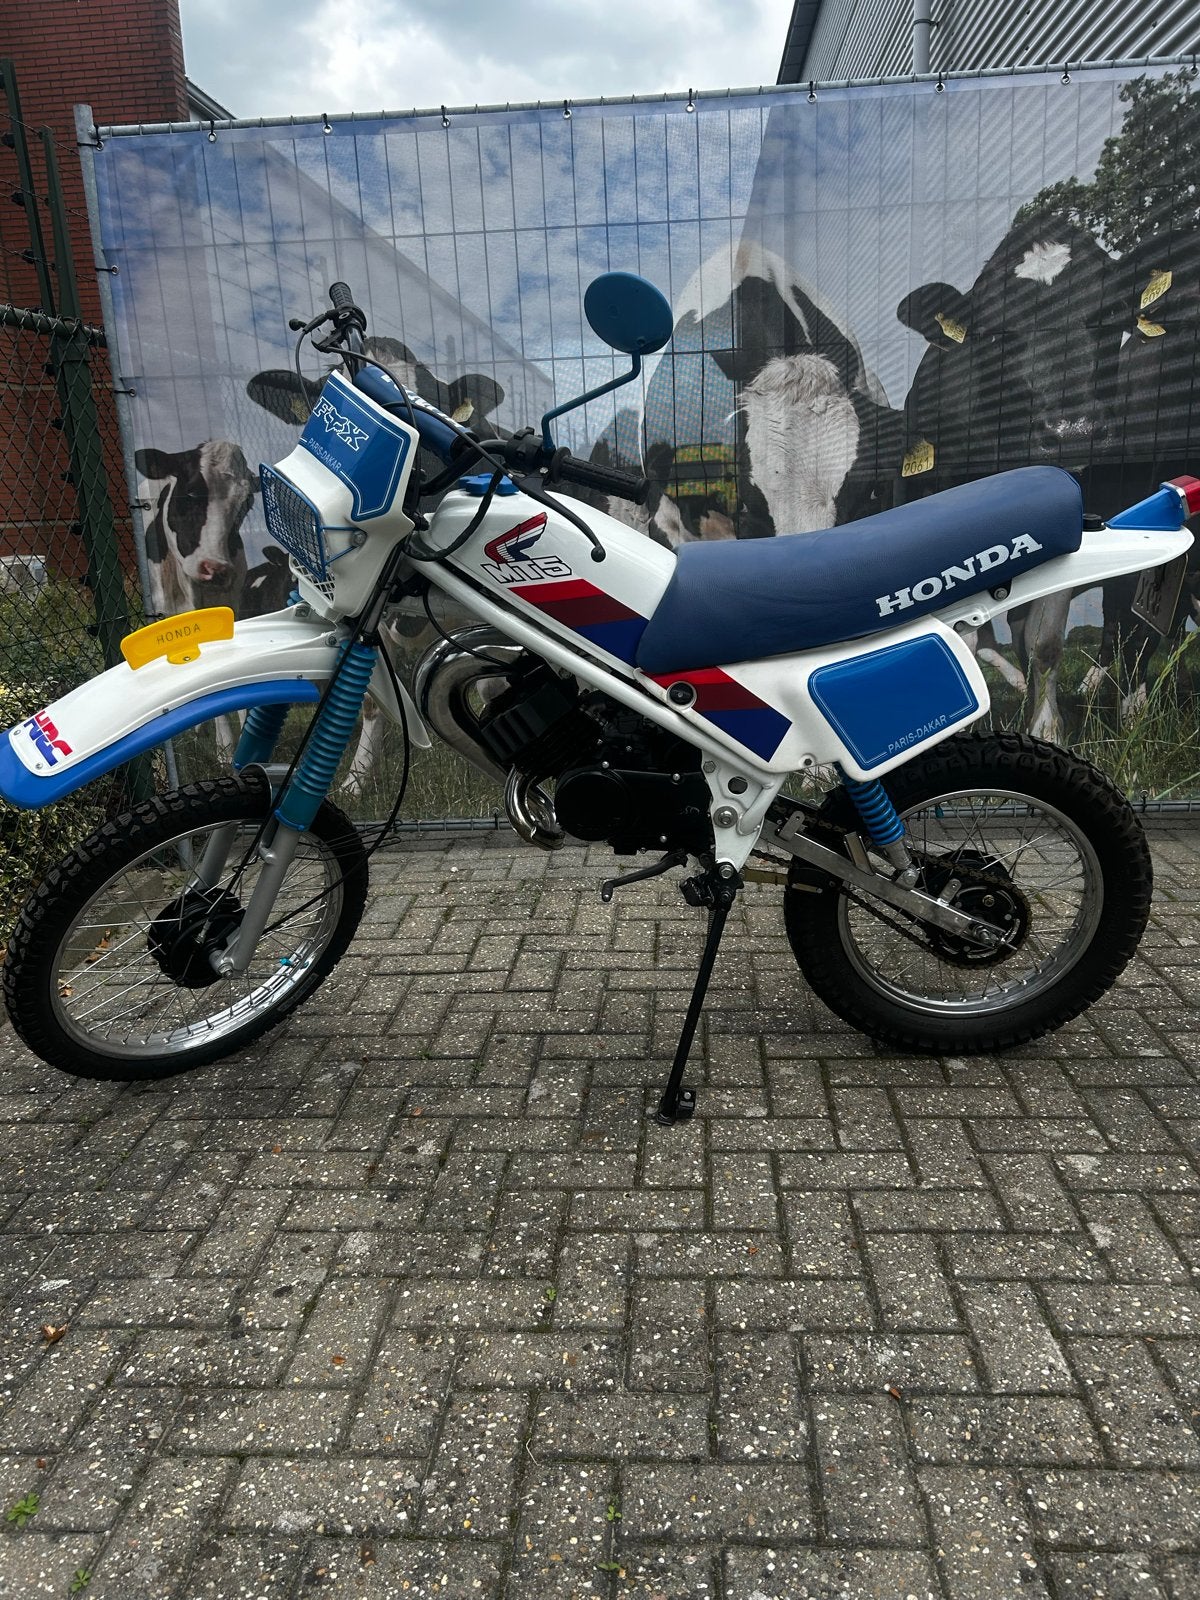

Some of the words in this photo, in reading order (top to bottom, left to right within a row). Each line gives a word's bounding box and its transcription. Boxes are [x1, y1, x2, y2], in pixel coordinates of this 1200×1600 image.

[307, 437, 342, 472] PARIS-DAKAR
[480, 555, 572, 584] MT5
[875, 533, 1043, 617] HONDA
[156, 623, 201, 645] HONDA
[888, 714, 947, 754] PARIS-DAKAR
